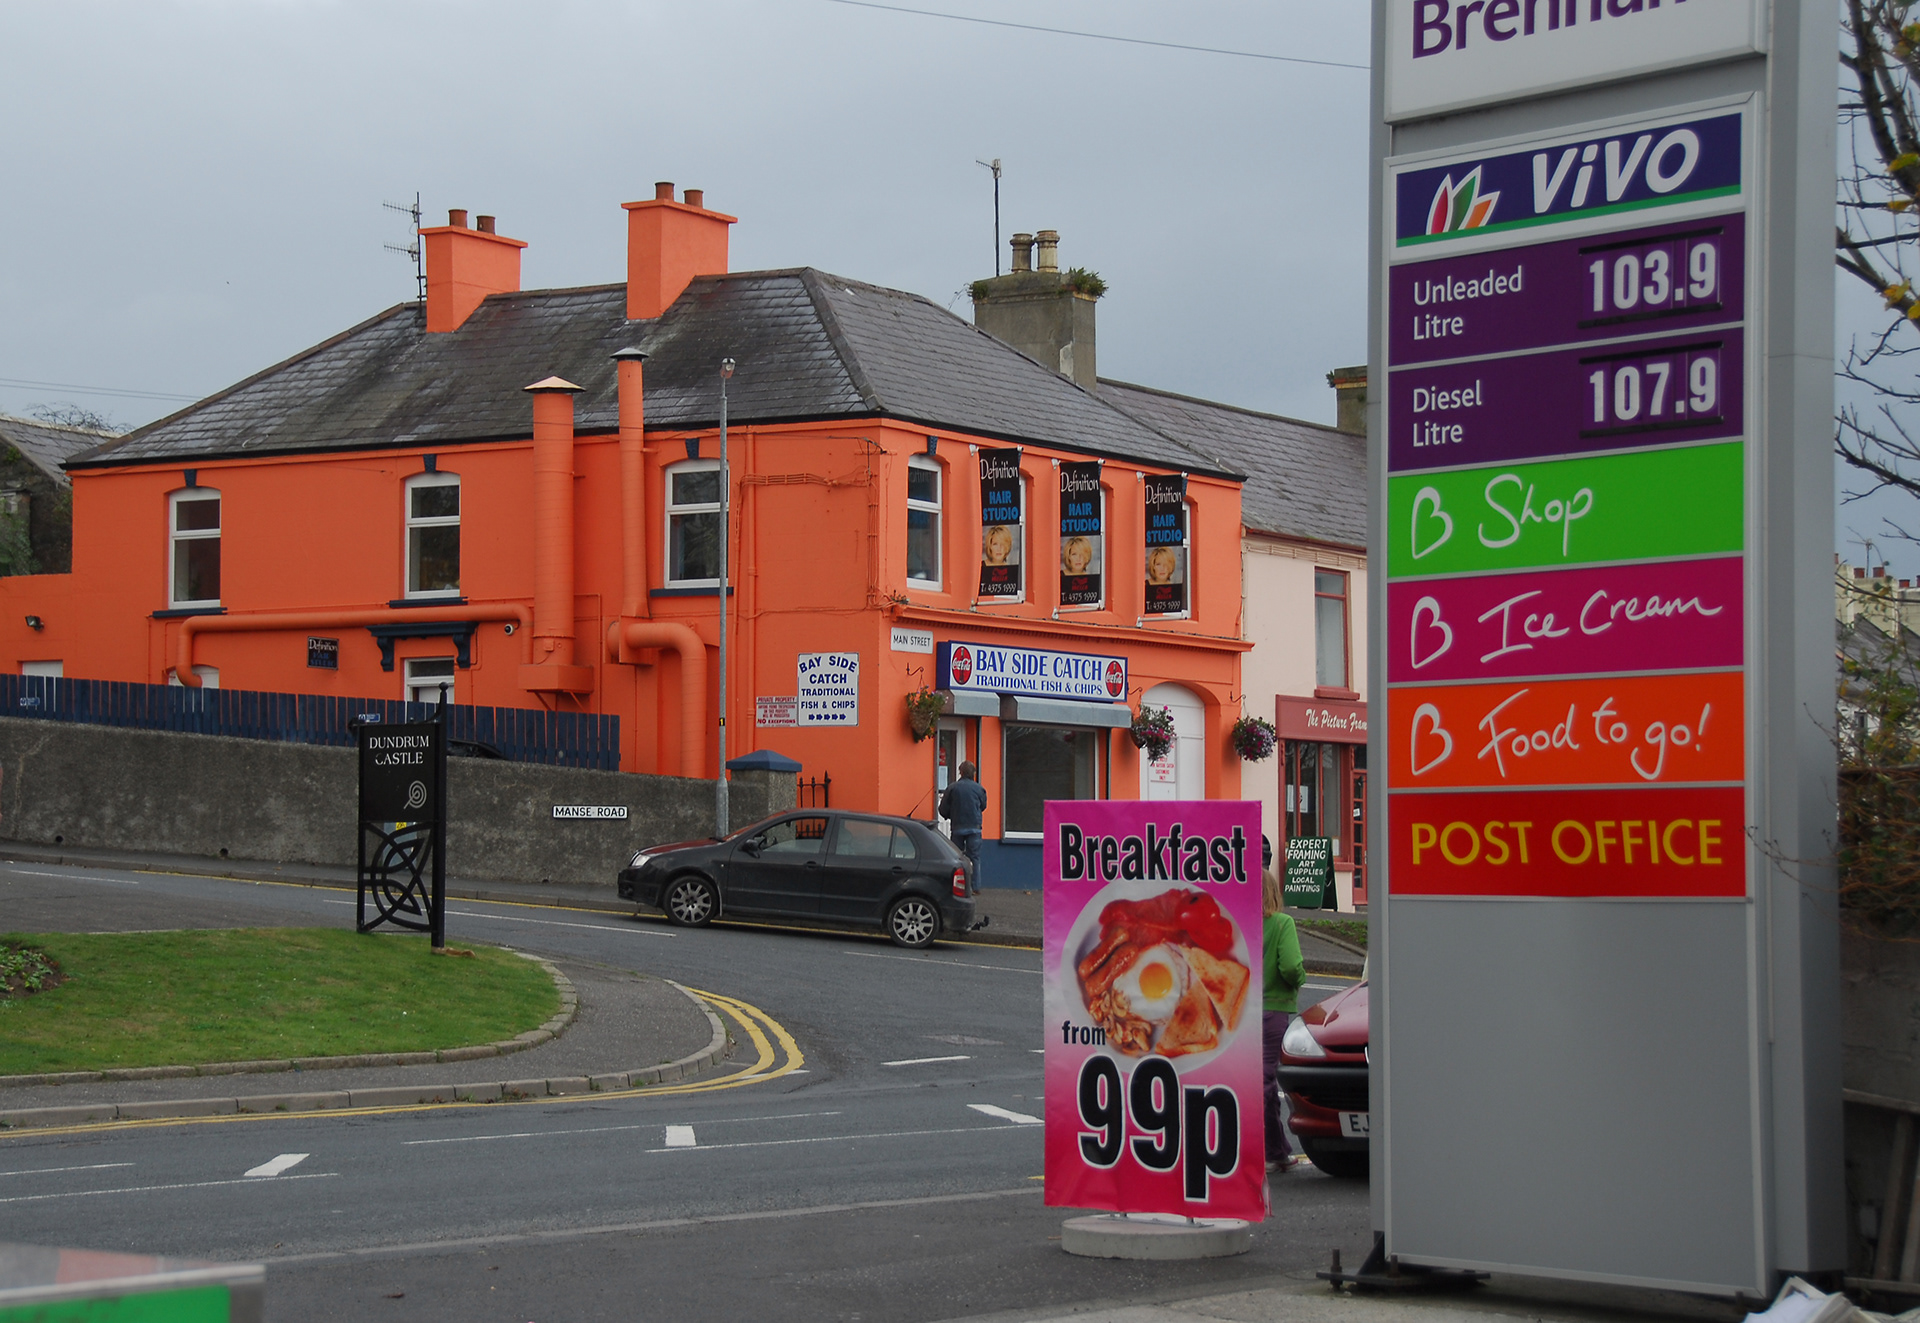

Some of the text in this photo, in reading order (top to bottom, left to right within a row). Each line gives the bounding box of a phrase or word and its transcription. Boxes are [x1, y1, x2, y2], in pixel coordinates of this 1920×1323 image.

[1412, 0, 1687, 59] Brenn
[1414, 243, 1716, 312] Unleaded 103.9
[1413, 313, 1463, 340] Litre
[1413, 357, 1716, 422] Diesel 107.9
[1413, 421, 1463, 447] Litre
[980, 457, 1018, 487] Definition
[1061, 470, 1099, 500] Definition
[989, 490, 1012, 504] HAIR
[1145, 483, 1182, 511] Definition
[983, 507, 1019, 521] STUDIO
[1069, 502, 1092, 516] HAIR
[1478, 474, 1593, 556] Shop
[1061, 518, 1099, 532] STUDIO
[1153, 514, 1175, 527] HAIR
[1146, 529, 1182, 543] STUDIO
[1478, 590, 1569, 663] Ice
[1579, 589, 1723, 635] Cream
[893, 634, 931, 647] MAIN STREET
[799, 656, 857, 673] BAY SIDE
[976, 649, 1102, 681] BAY SIDE CATCH
[809, 673, 847, 684] CATCH
[975, 674, 1103, 696] TRADITIONAL FISH & CHIPS
[801, 688, 855, 696] TRADITIONAL
[801, 700, 819, 709] FISH
[822, 700, 827, 709] &
[832, 700, 855, 709] CHIPS
[1306, 708, 1319, 727] The
[1321, 709, 1347, 728] Picture
[370, 735, 429, 749] DUNDRUM
[1478, 689, 1579, 778] Food
[1592, 697, 1627, 743] to
[1630, 703, 1711, 780] go!
[375, 751, 424, 766] CASTLE
[555, 807, 626, 817] MANSE ROAD
[1290, 838, 1327, 849] EXPERT
[1411, 818, 1723, 866] POST OFFICE
[1059, 822, 1248, 884] Breakfast
[1287, 849, 1326, 860] FRAMING
[1288, 867, 1324, 876] SUPPLIES
[1298, 860, 1315, 868] ART
[1285, 884, 1321, 892] PAINTINGS
[1062, 1020, 1106, 1045] from
[1076, 1053, 1240, 1203] 99p
